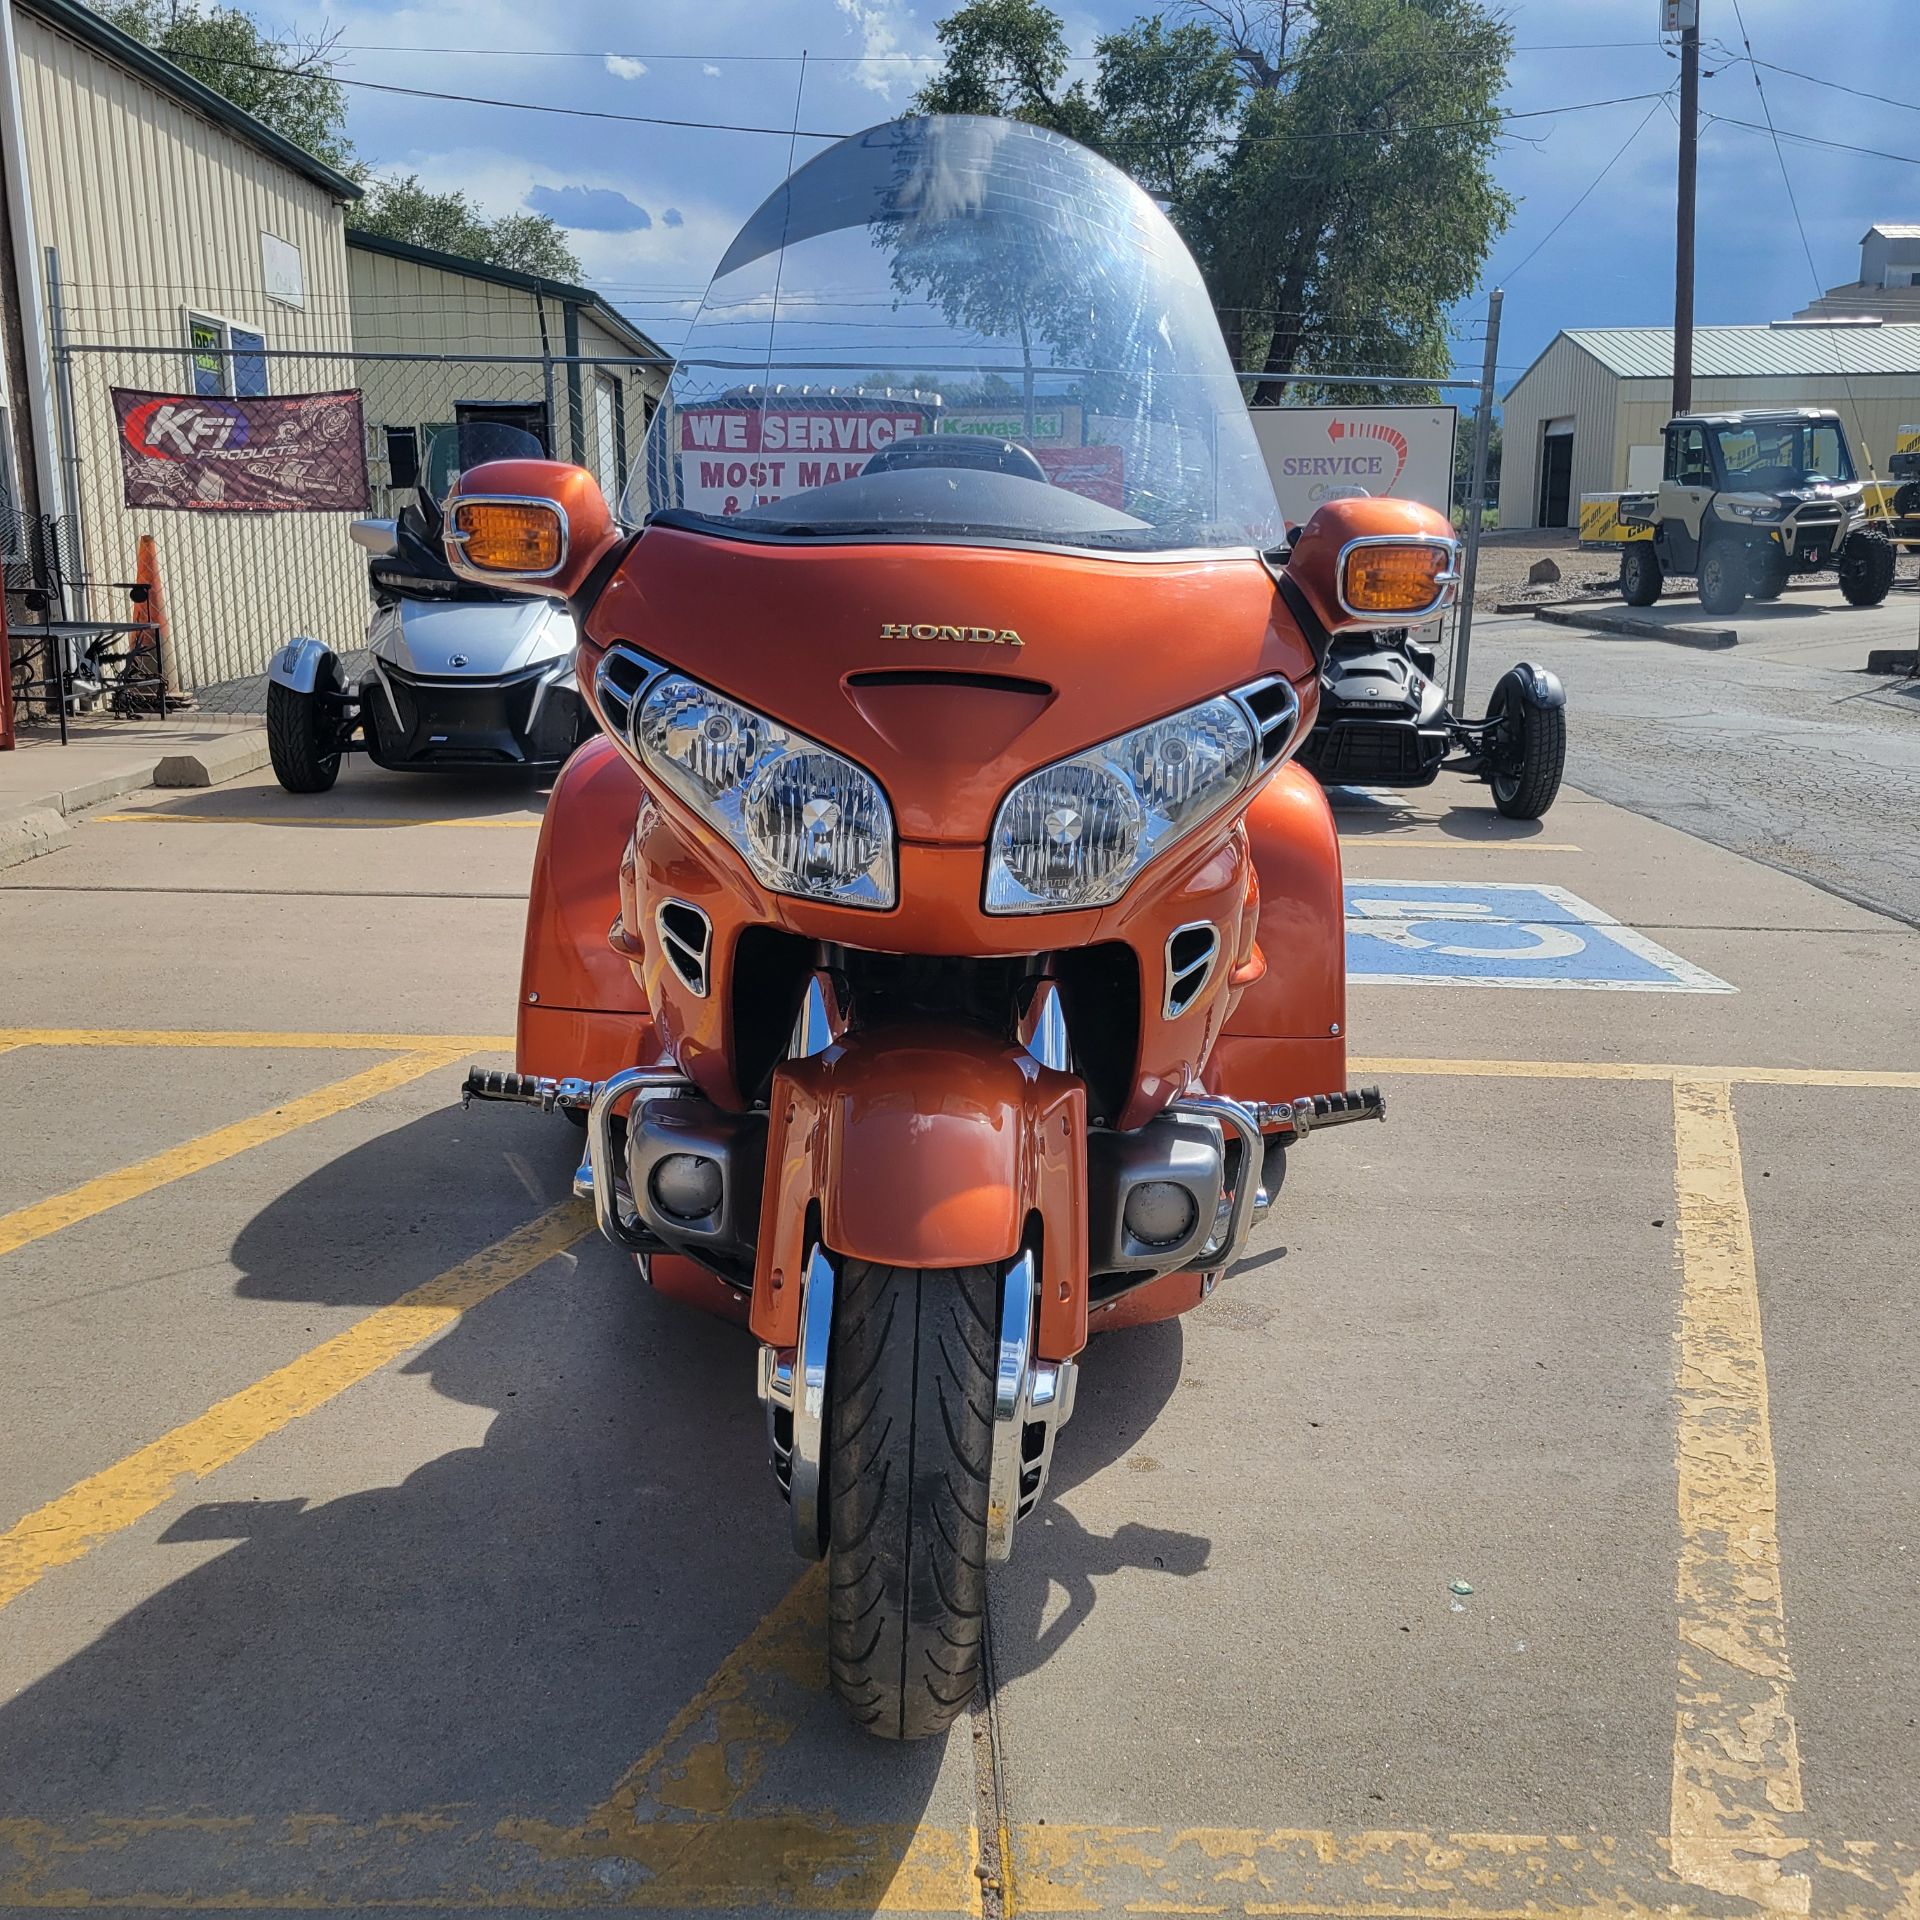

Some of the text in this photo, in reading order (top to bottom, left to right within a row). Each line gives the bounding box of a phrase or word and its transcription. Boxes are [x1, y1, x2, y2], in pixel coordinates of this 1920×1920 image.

[689, 415, 916, 450] WE SERVICE
[943, 416, 1057, 435] Kawaski
[197, 444, 300, 459] PRODUCTS
[701, 461, 865, 488] MOST MAK
[1282, 456, 1383, 476] SERVICE
[879, 623, 1026, 646] HONDA
